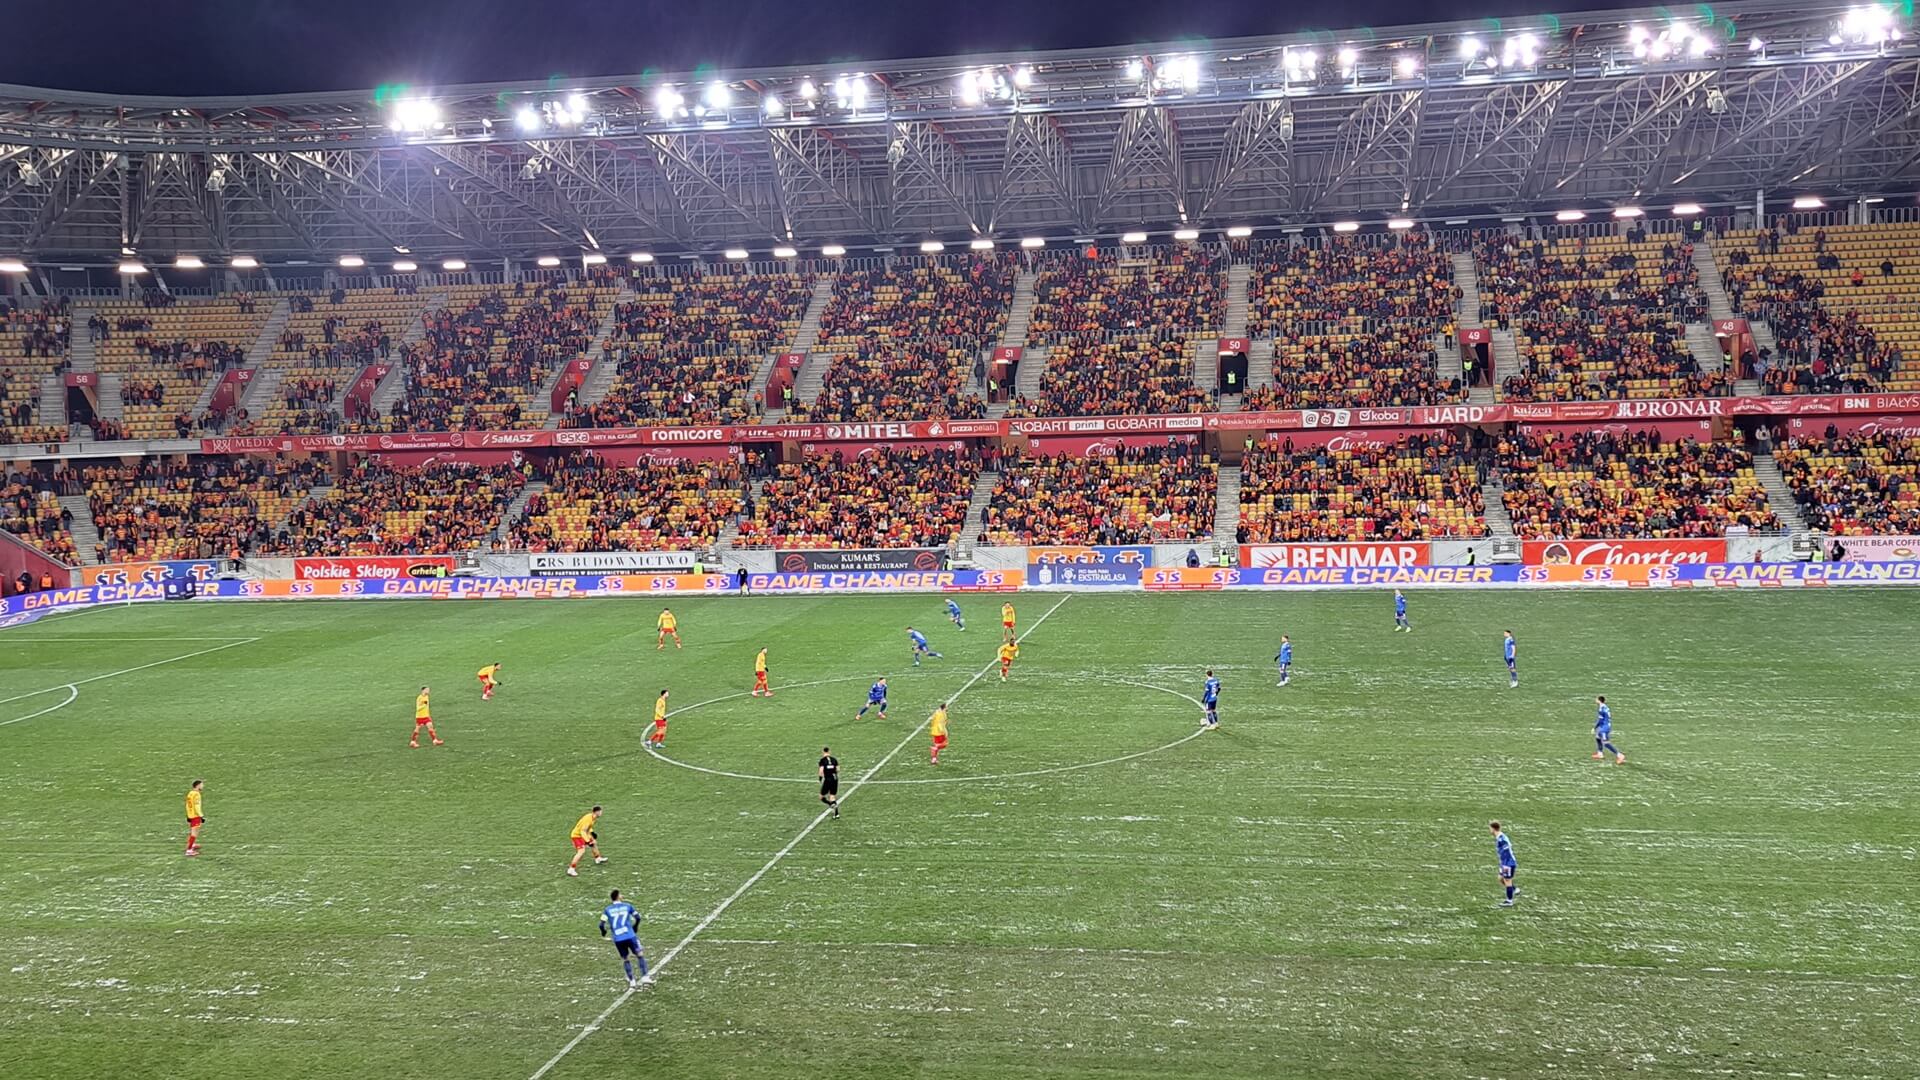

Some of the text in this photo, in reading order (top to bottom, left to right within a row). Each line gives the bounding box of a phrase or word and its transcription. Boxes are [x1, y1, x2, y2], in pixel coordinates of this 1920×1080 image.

[1722, 322, 1734, 331] 48
[1468, 331, 1480, 340] 49
[1229, 341, 1241, 350] 50
[1005, 349, 1014, 358] 51
[788, 356, 799, 364] 52
[579, 362, 589, 370] 53
[238, 371, 248, 379] 55
[376, 367, 386, 376] 54
[1635, 400, 1723, 417] PRONAR
[1371, 410, 1399, 421] koba
[1429, 407, 1483, 423] JARD
[1074, 420, 1098, 430] print
[1107, 418, 1165, 430] GLOBART
[1168, 417, 1198, 426] media
[1699, 421, 1709, 429] 16
[1792, 419, 1802, 428] 16
[845, 424, 914, 438] MITEL
[951, 425, 972, 433] pizza
[652, 429, 723, 441] romicore
[235, 438, 274, 448] MEDIX
[1031, 440, 1040, 448] 19
[728, 446, 738, 454] 20
[805, 444, 815, 452] 20
[1842, 539, 1869, 547] WHITE
[1871, 539, 1894, 547] BEAR
[841, 553, 881, 562] KUMAR'S
[1576, 542, 1708, 565] Chorten
[547, 554, 688, 567] RS BUDOWNICTWO
[813, 562, 839, 570] INDIAN
[303, 564, 400, 579] Polskie Sklepy
[1263, 567, 1493, 583] GAME CHANGER
[1705, 563, 1920, 580] GAME CHANG
[751, 575, 826, 588] GAME
[829, 572, 955, 588] CHANGER
[1078, 573, 1127, 582] EKSTRAKLASA
[383, 577, 577, 593] GAME CHANGER
[24, 588, 93, 610] GAME
[98, 582, 219, 602] CHAER
[610, 911, 628, 928] 77
